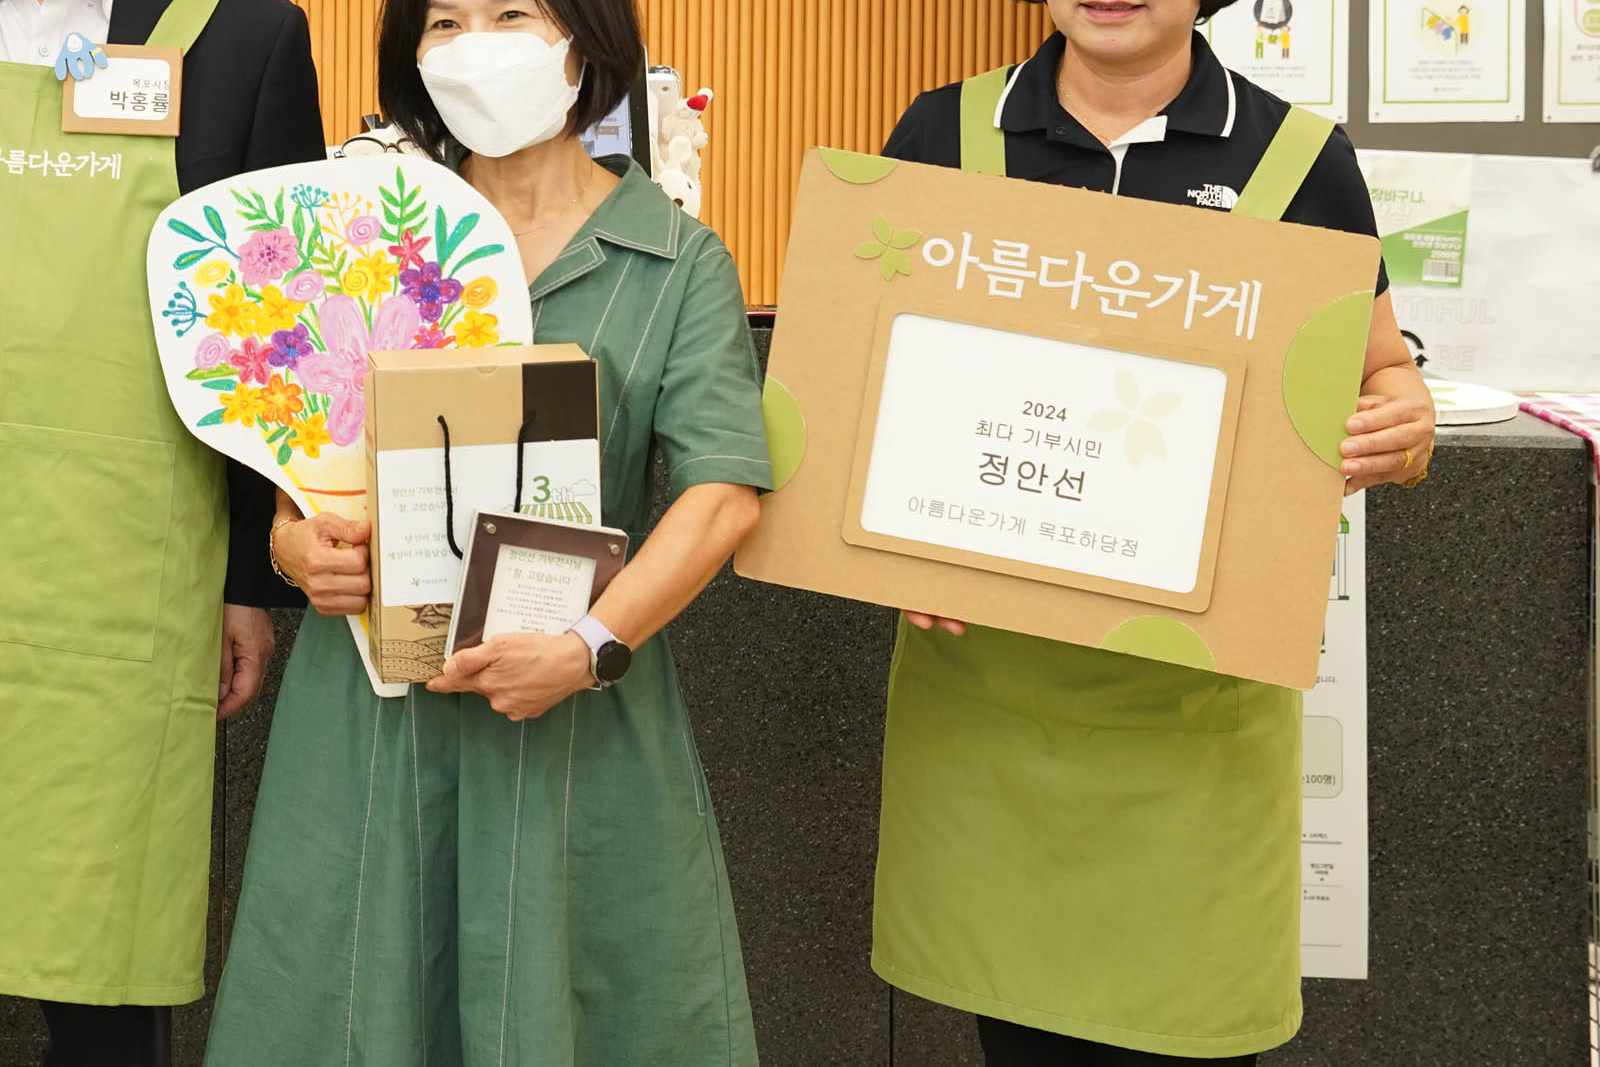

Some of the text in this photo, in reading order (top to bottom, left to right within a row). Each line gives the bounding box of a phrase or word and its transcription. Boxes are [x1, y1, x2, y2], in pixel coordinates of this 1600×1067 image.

[110, 91, 169, 113] 박홍률
[1187, 189, 1223, 201] NORTH
[1203, 184, 1222, 193] THE
[1197, 197, 1222, 207] FACE
[922, 231, 1262, 340] 아름다운가게
[1022, 400, 1068, 422] 2024
[974, 419, 1103, 459] 최다 기부시민
[979, 452, 1086, 502] 정안선
[907, 495, 1139, 558] 아름다운가게 목포하당점
[1302, 774, 1337, 786] 100명)
